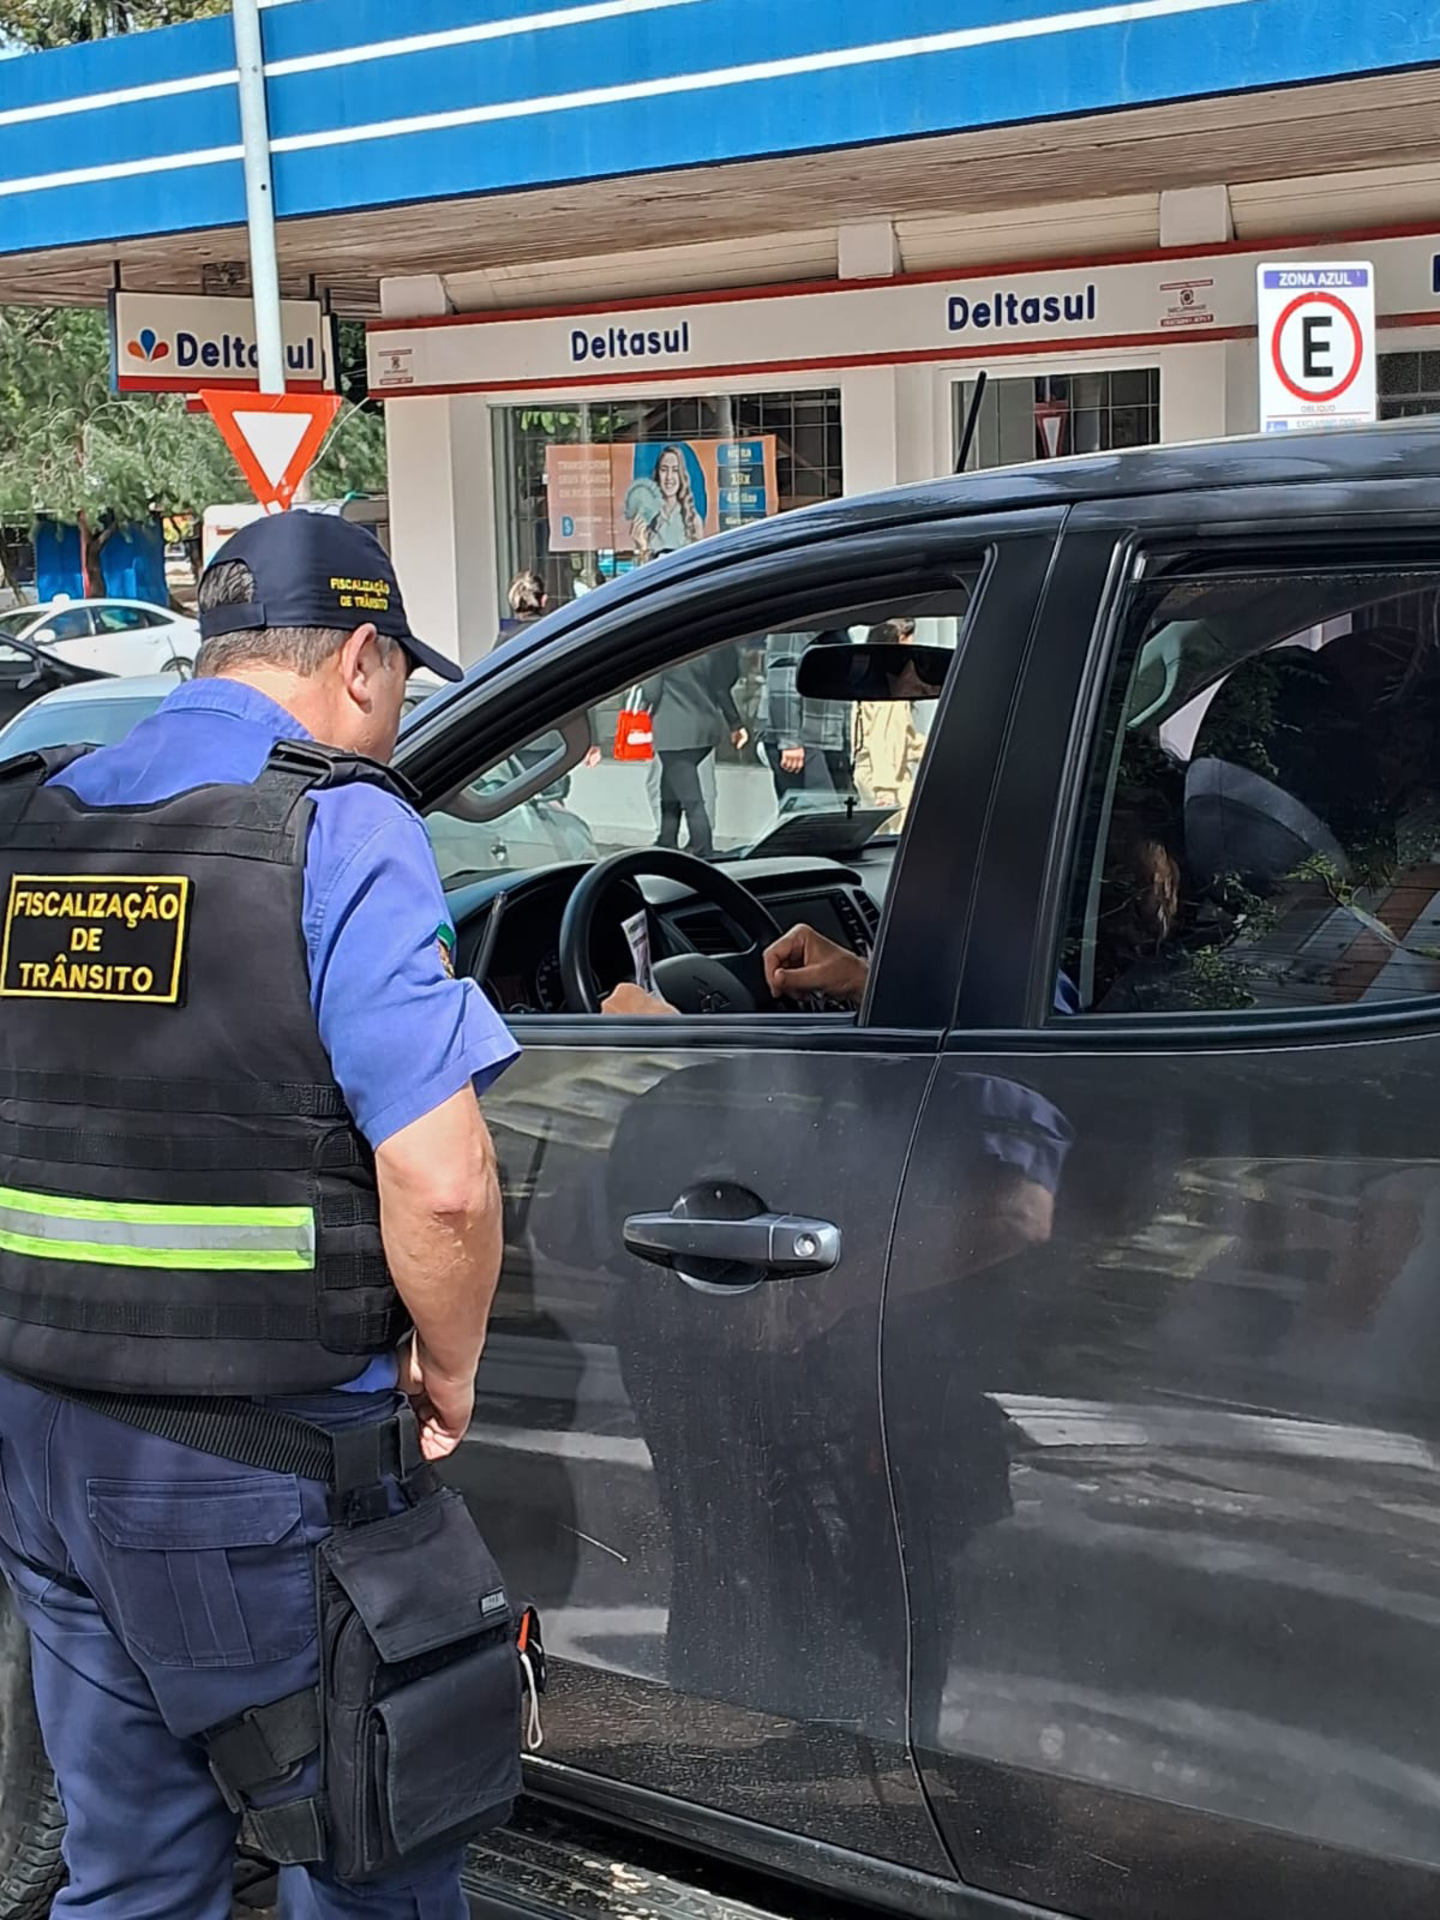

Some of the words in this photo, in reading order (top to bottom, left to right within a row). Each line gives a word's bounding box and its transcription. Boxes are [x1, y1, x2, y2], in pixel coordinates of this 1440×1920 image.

[1278, 272, 1315, 286] ZONA
[1317, 271, 1351, 285] AZUL
[948, 284, 1096, 330] Deltasul
[571, 321, 689, 361] Deltasul
[1302, 316, 1333, 378] E
[330, 577, 390, 597] FISCALIZAÇÃO
[340, 595, 353, 607] DE
[14, 885, 180, 928] FISCALIZAÇÃO
[70, 928, 103, 952] DE
[19, 953, 153, 992] TRÂNSITO
